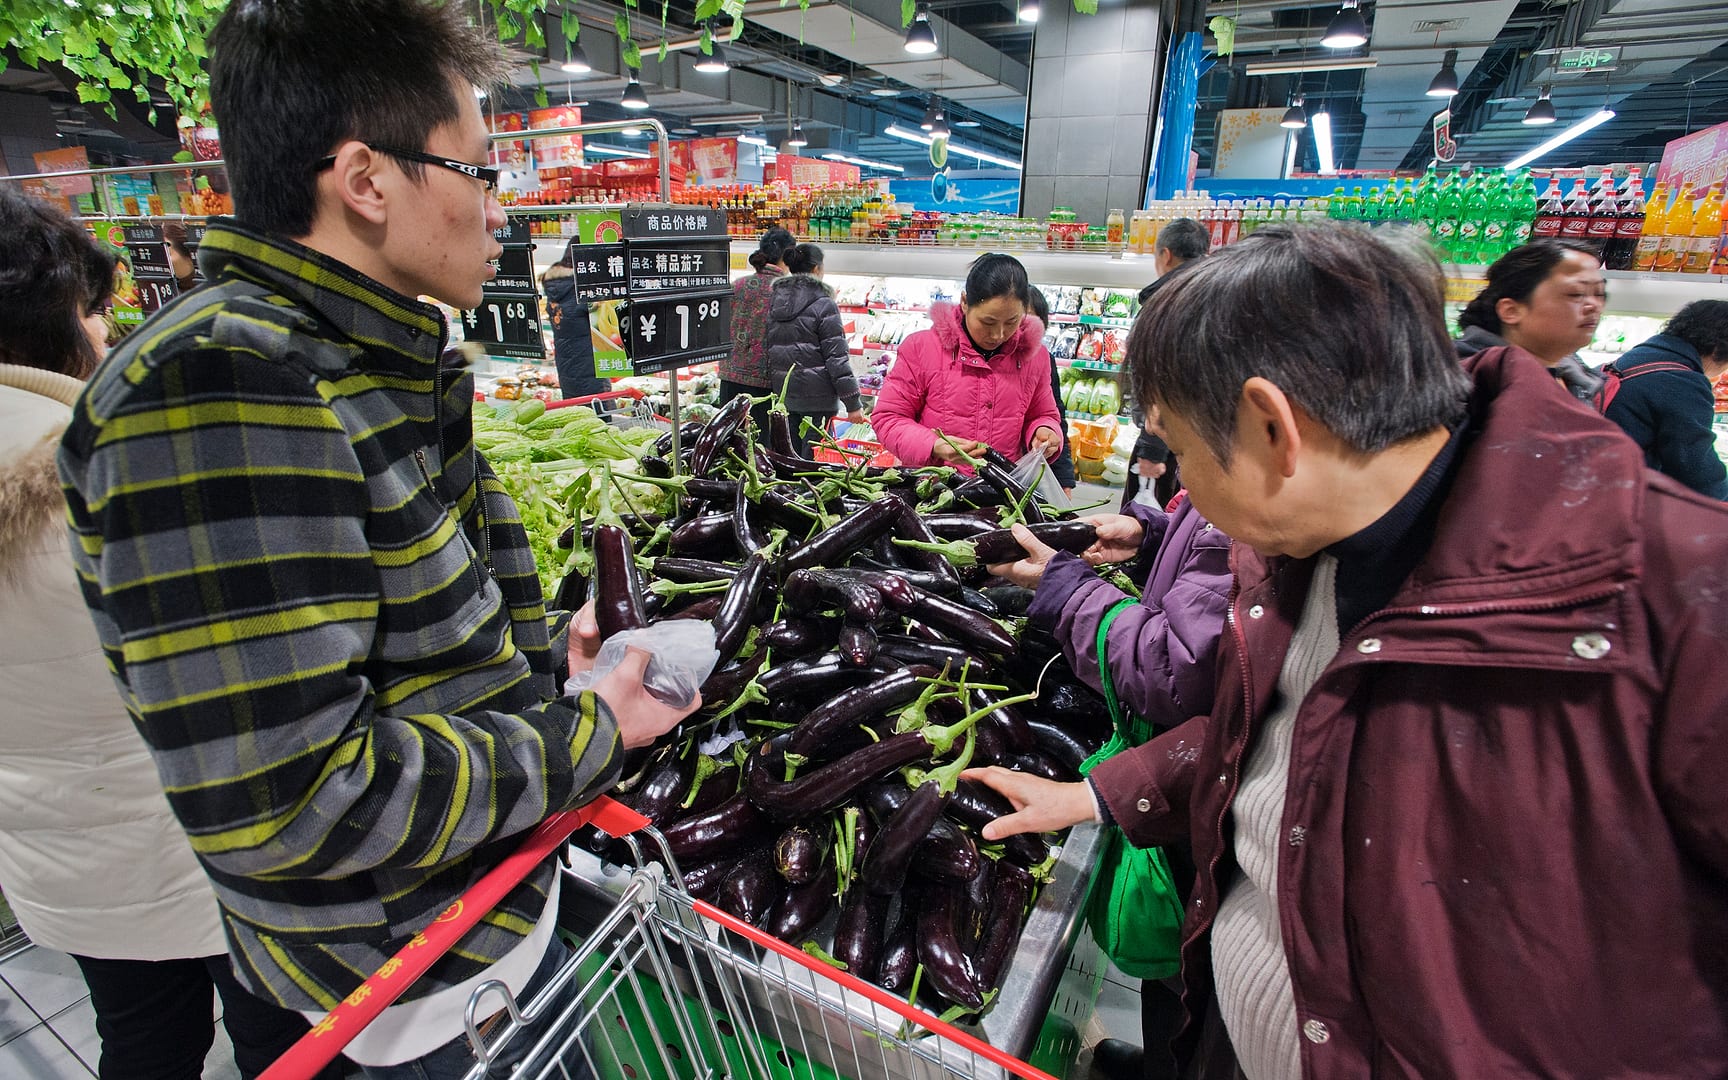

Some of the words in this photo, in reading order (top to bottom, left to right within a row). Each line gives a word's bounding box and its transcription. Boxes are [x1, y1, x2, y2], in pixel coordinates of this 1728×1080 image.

[648, 214, 708, 231] 商品价格牌
[608, 255, 624, 278] 精
[631, 257, 653, 270] 品名:
[656, 254, 703, 273] 精品茄子
[488, 302, 526, 343] 1.68
[640, 313, 657, 343] ¥
[675, 300, 720, 350] 1.98
